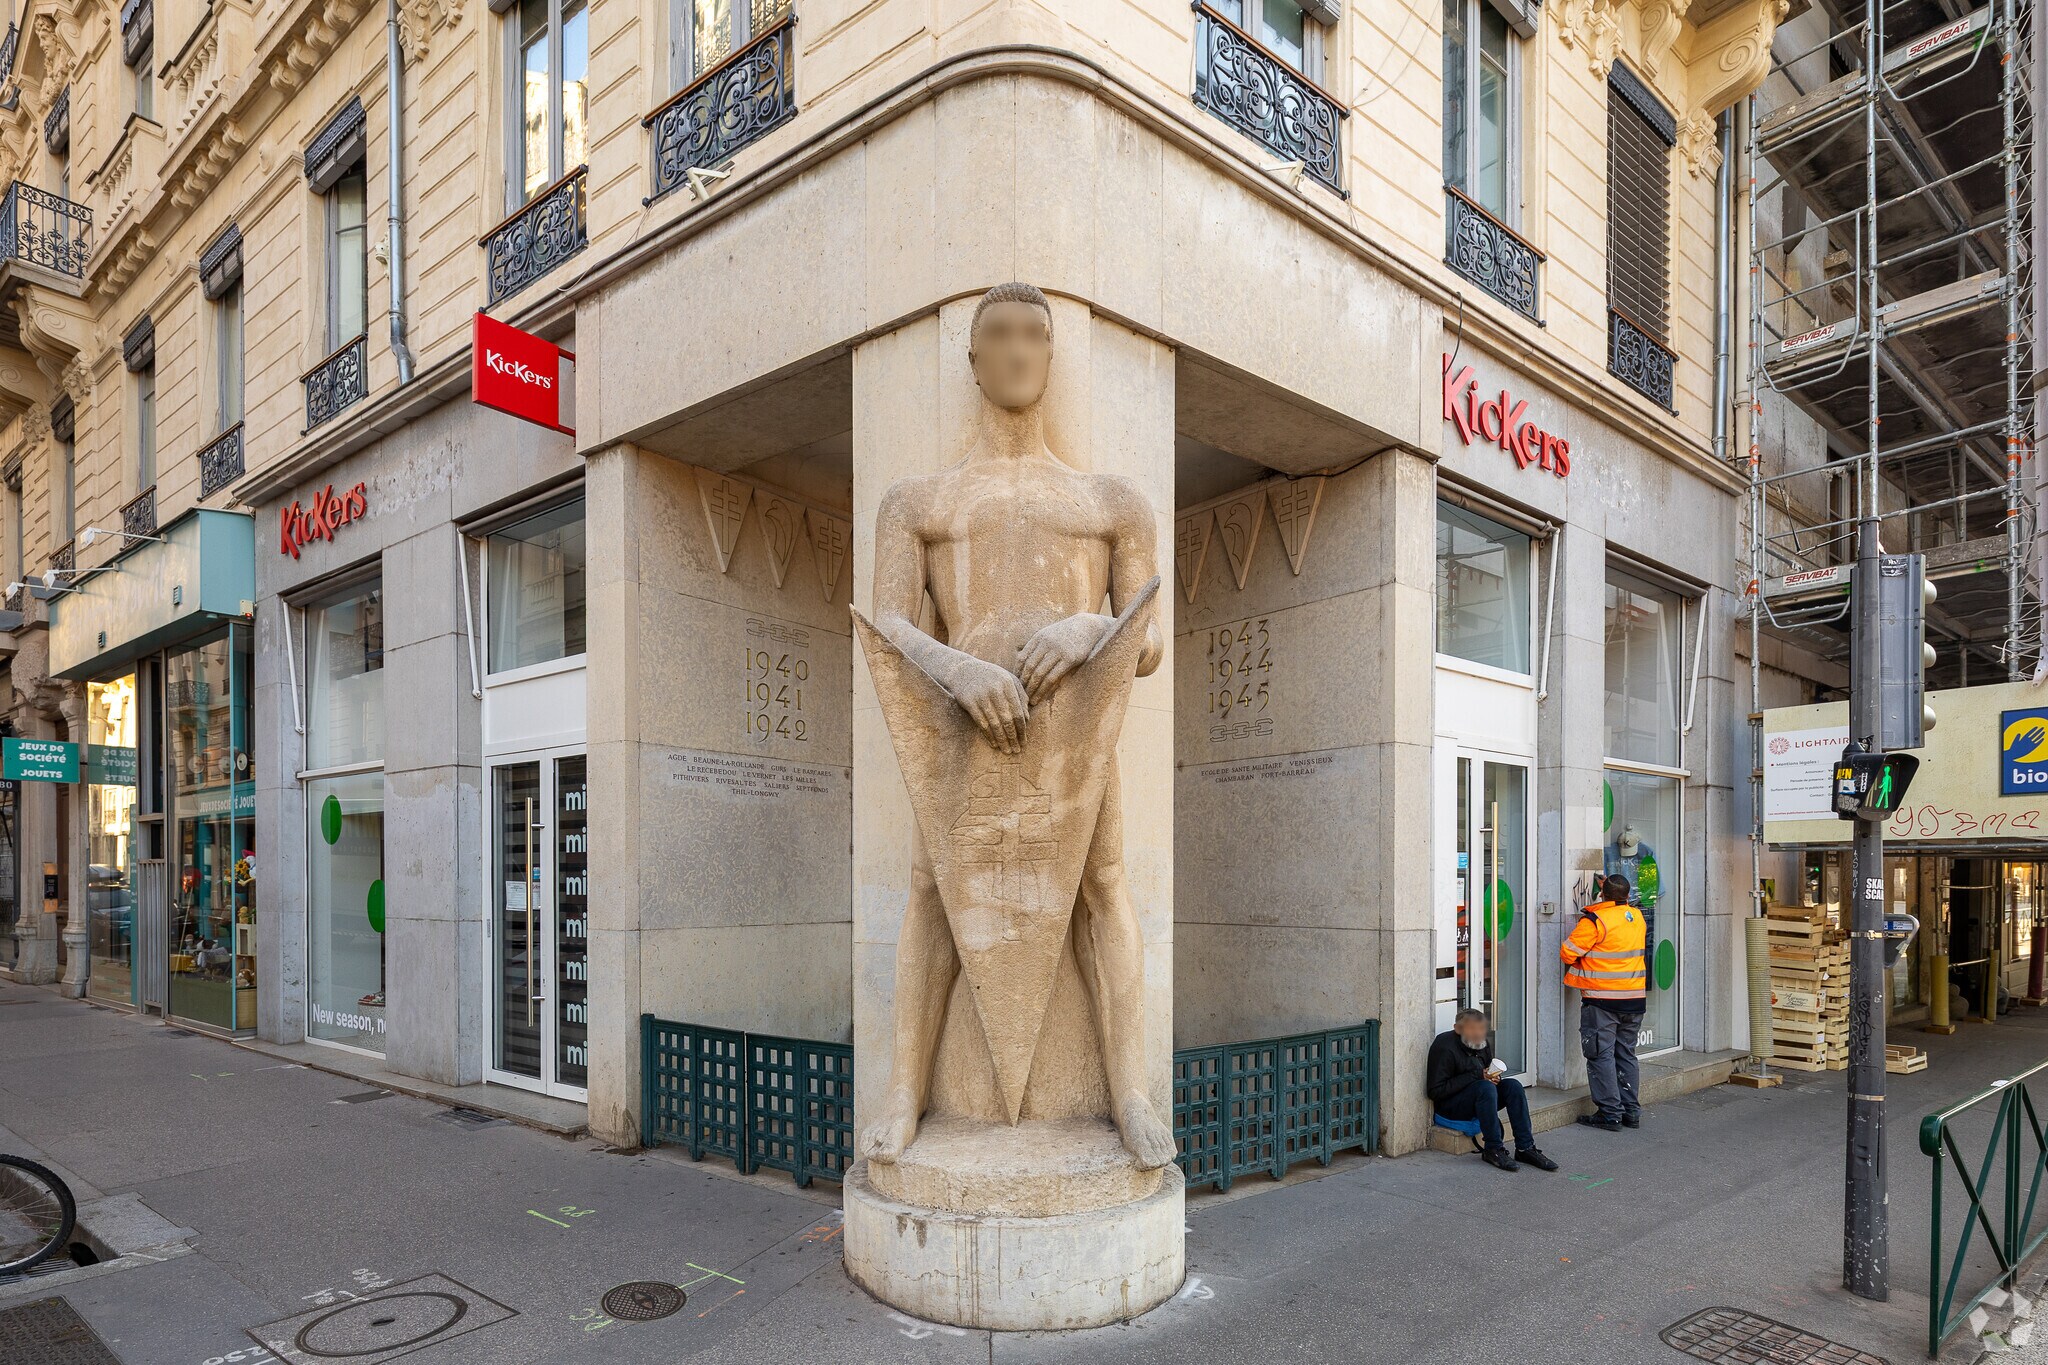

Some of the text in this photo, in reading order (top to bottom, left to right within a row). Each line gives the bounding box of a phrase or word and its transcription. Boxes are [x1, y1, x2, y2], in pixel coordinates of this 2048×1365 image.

[1909, 21, 1969, 56] SERVIBAT
[1783, 325, 1835, 348] SERVIBAT
[1785, 568, 1837, 584] SERVIBAT
[1207, 619, 1269, 658] 1943
[746, 648, 808, 680] 1940
[1209, 648, 1273, 688] 1944
[746, 680, 802, 711] 1941
[1209, 682, 1269, 719] 1945
[746, 712, 808, 742] 1942
[18, 742, 47, 751] JEUX
[1795, 737, 1849, 748] LIGHTAIR
[667, 754, 687, 762] AGDE
[693, 756, 765, 770] BEAUNE-LA-ROLLANDE
[1252, 762, 1283, 771] MILITAIRE
[1289, 756, 1333, 767] VENISSIEUX
[20, 769, 63, 778] JOUETS
[752, 772, 776, 780] VERNET
[2012, 768, 2048, 785] bio
[672, 774, 829, 793] PITHIVIERS RIVESALTES SALIERS SEPTFONDS
[732, 789, 780, 798] THIL-LONGWY
[313, 1003, 334, 1025] New
[336, 1011, 374, 1036] season,
